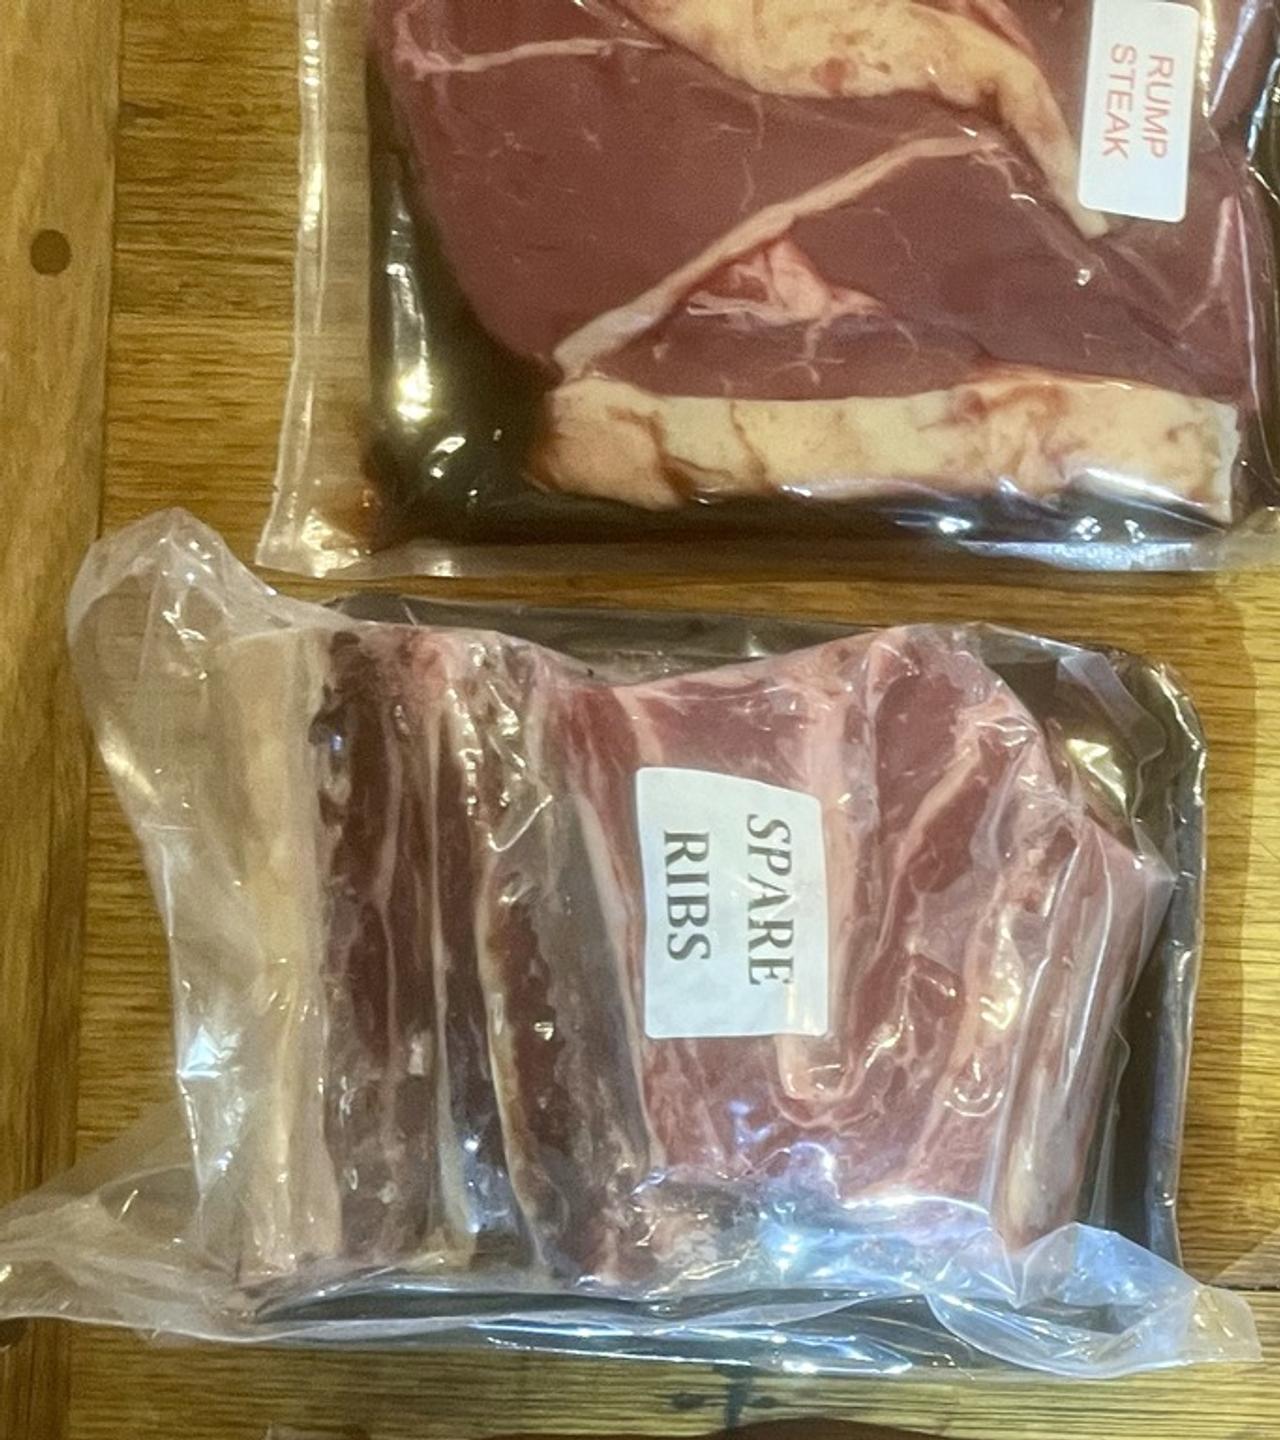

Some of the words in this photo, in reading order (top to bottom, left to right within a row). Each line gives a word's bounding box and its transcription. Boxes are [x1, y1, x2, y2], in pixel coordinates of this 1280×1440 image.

[1102, 43, 1137, 159] STEAK
[1142, 54, 1174, 158] RUMP
[664, 830, 711, 961] RIBS
[746, 813, 795, 986] SPARE
